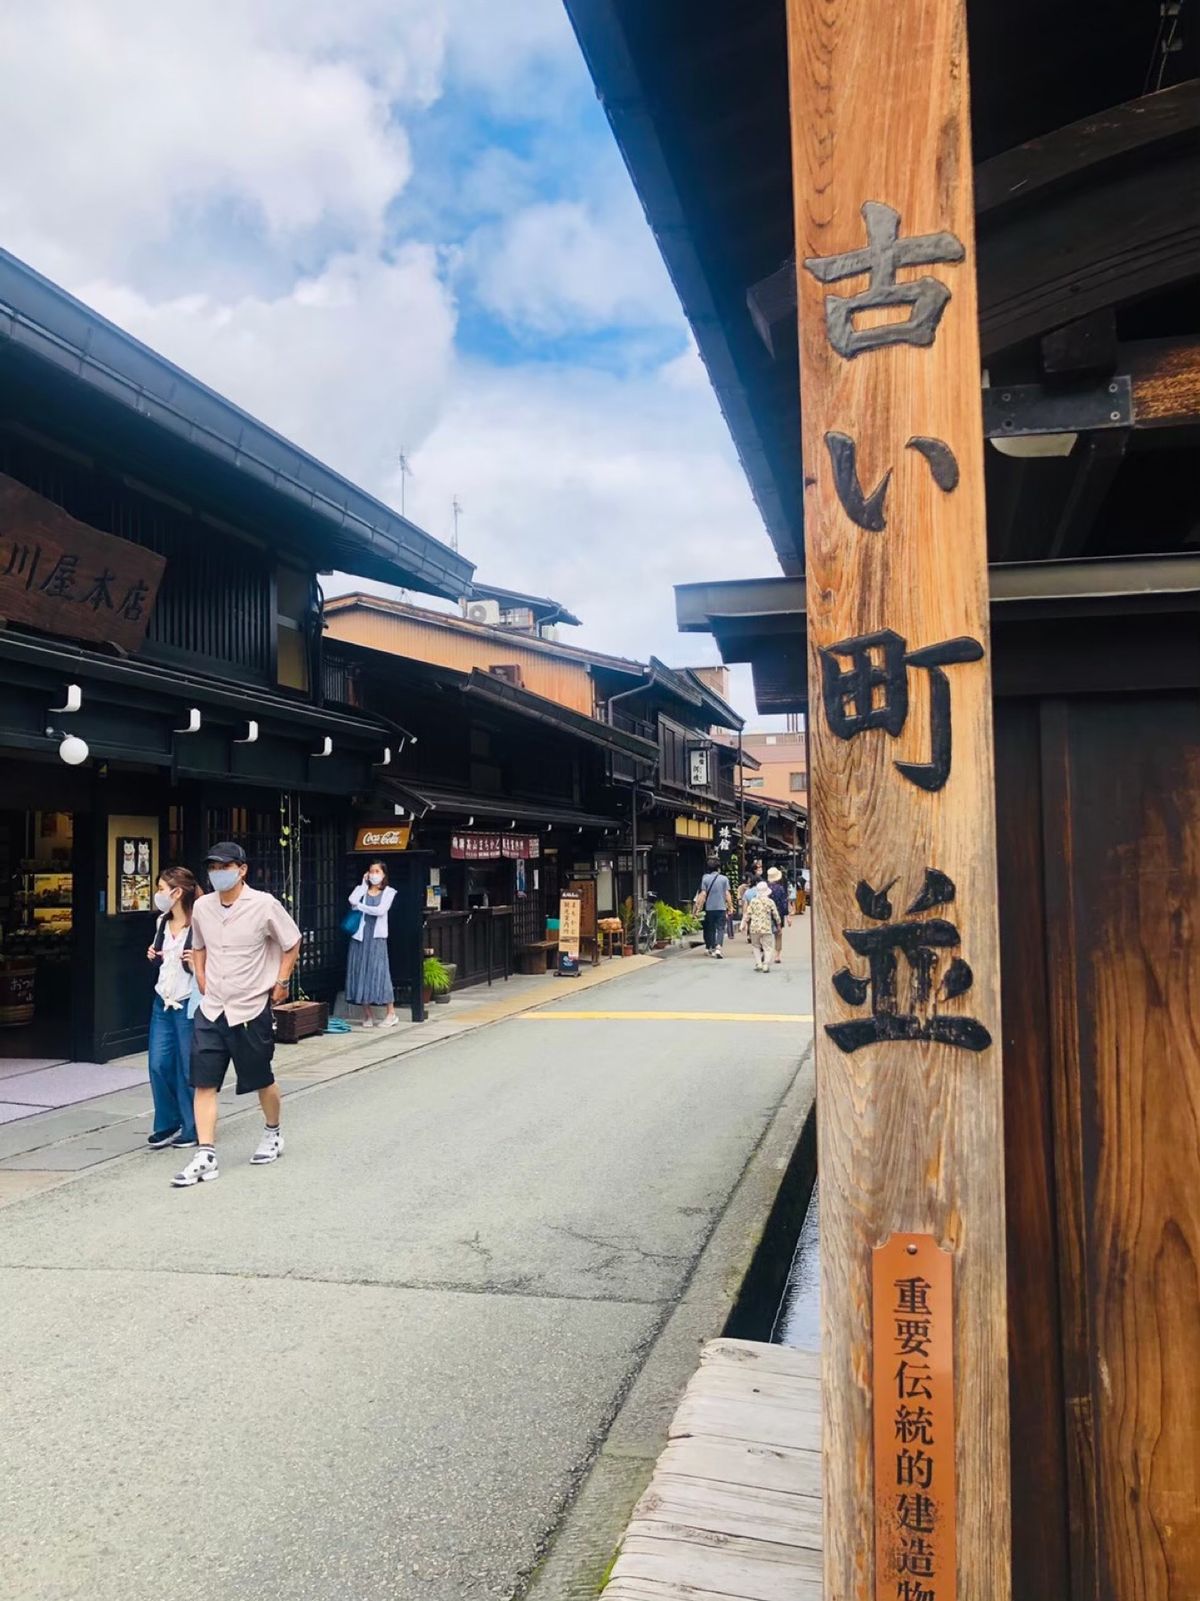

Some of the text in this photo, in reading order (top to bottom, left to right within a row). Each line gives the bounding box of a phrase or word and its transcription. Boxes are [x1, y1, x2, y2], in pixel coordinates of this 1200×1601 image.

[3, 542, 150, 621] 川屋本店
[804, 201, 991, 1053] 古い町並
[893, 1276, 936, 1601] 重要伝統的建造物
